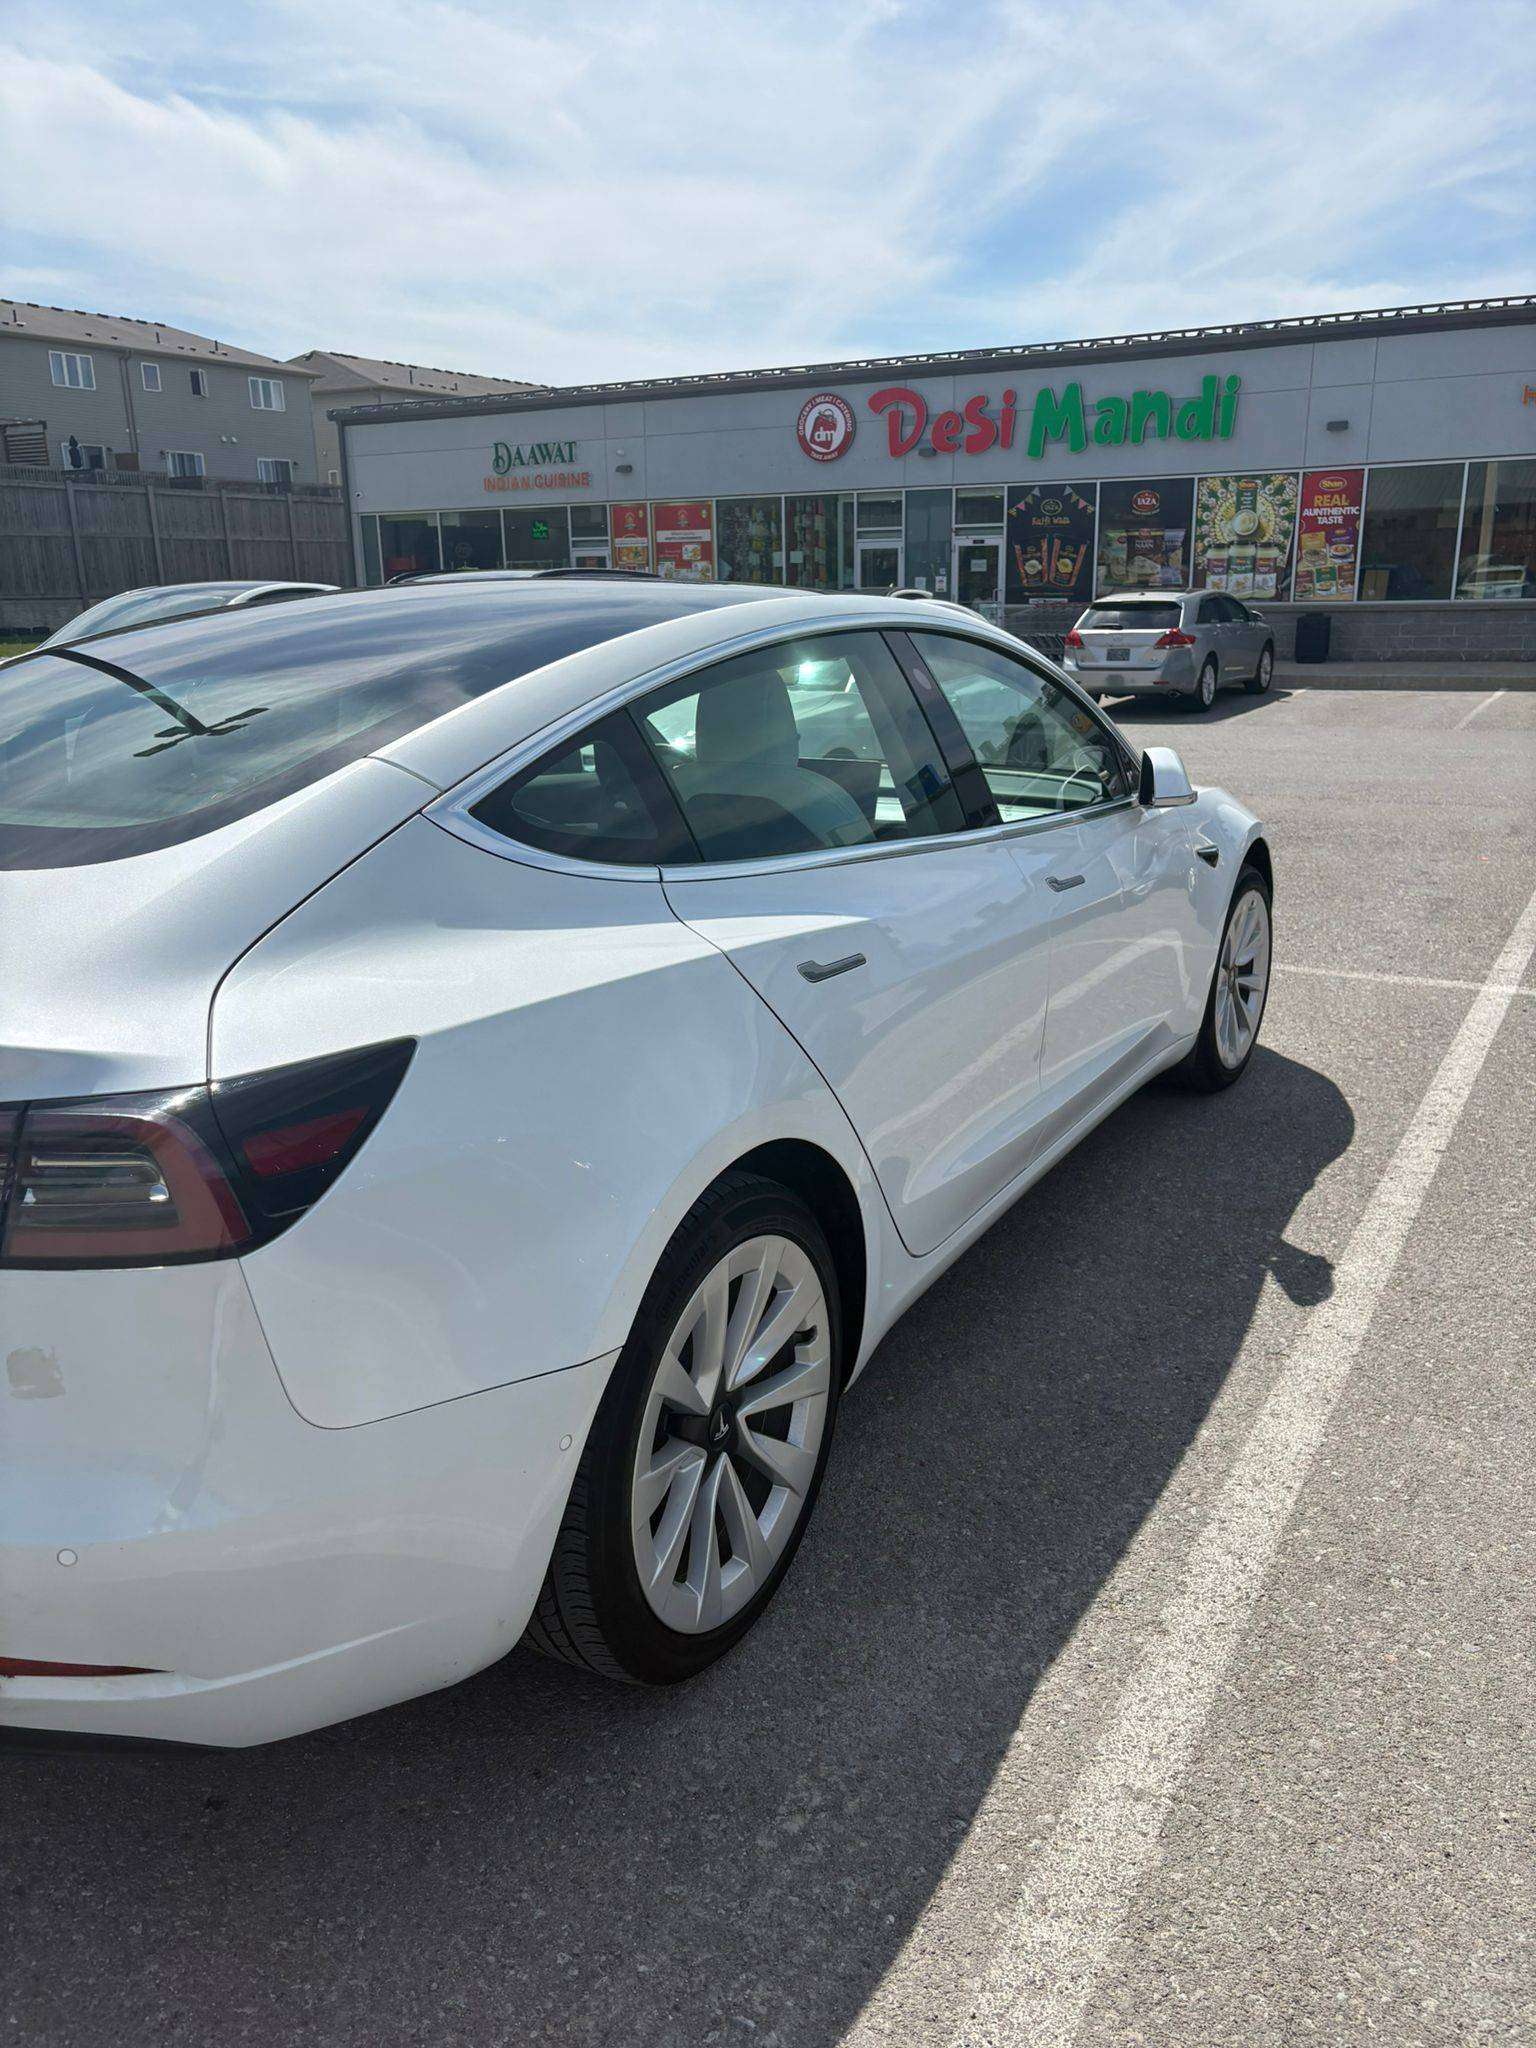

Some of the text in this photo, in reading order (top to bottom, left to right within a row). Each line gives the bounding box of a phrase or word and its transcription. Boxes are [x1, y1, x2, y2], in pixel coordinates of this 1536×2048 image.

[799, 402, 813, 435] GROCERY
[835, 399, 852, 432] CATERING
[1027, 374, 1241, 460] Mandi
[483, 472, 591, 491] INDIAN CUISINE
[1314, 494, 1350, 507] REAL
[1303, 506, 1360, 517] AUNTHENTIC
[1317, 516, 1344, 525] TASTE
